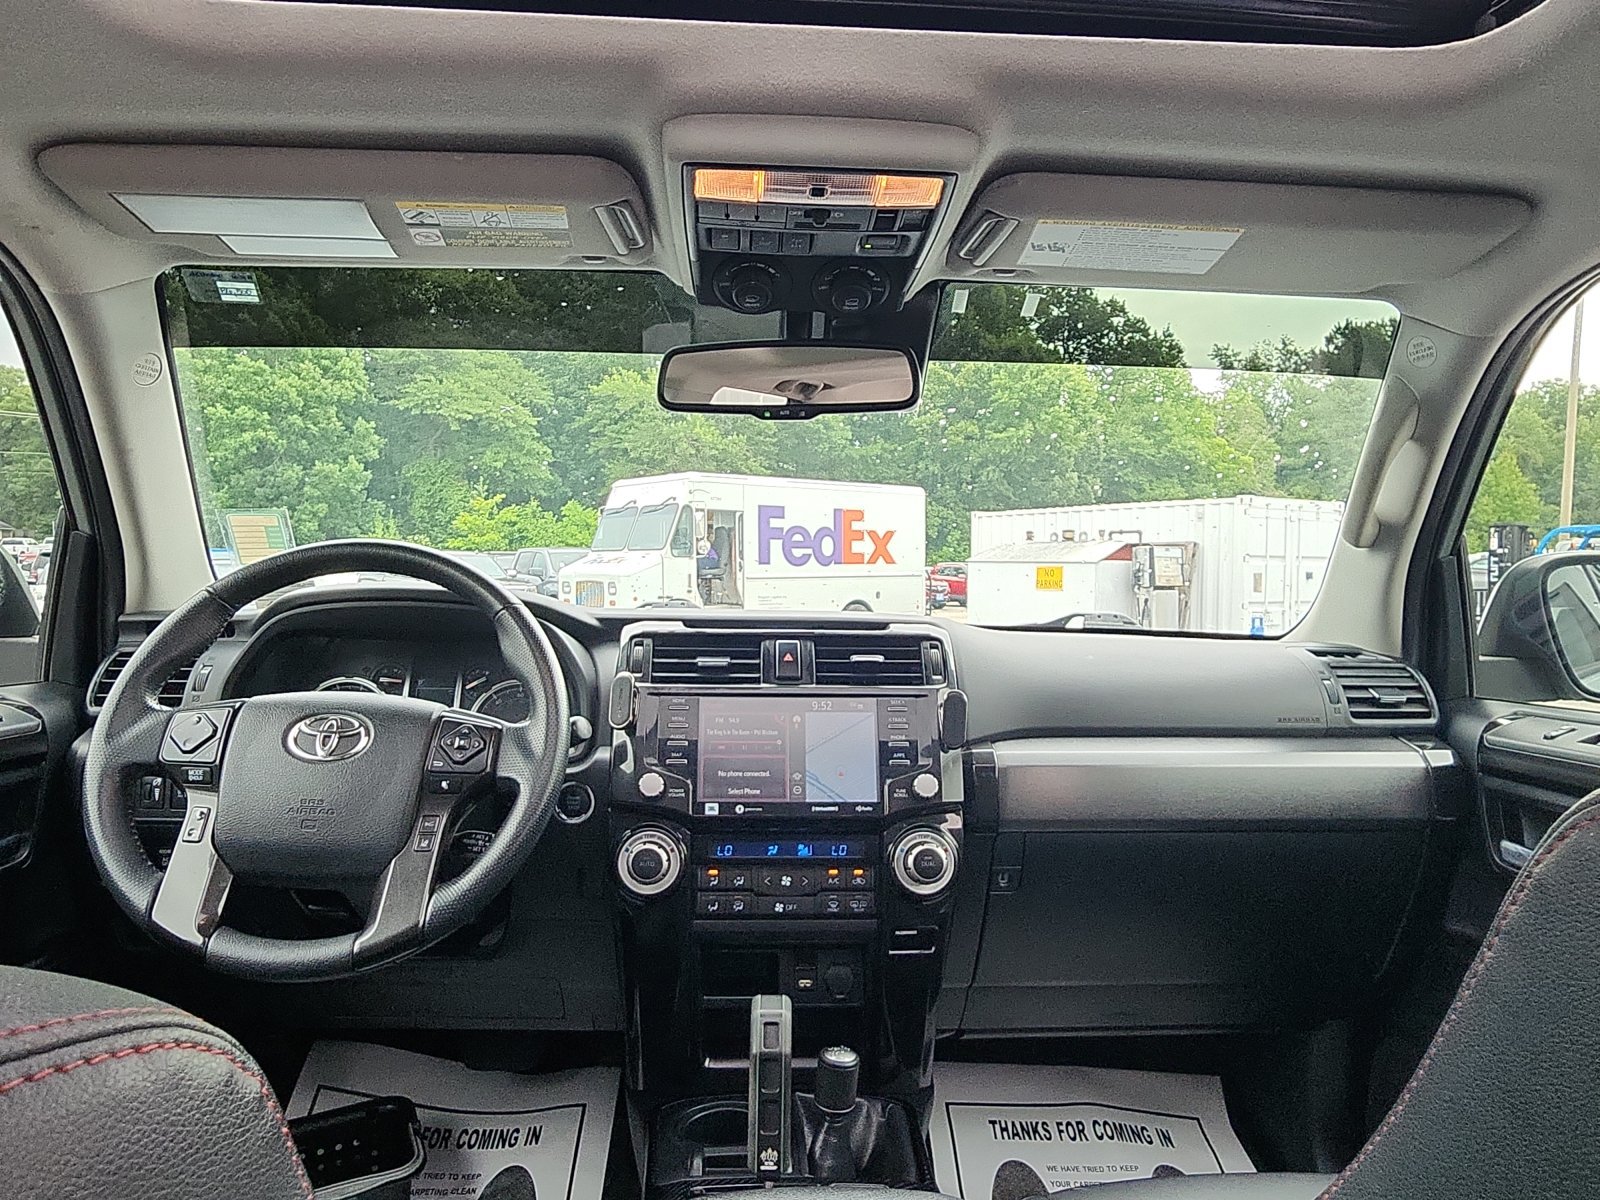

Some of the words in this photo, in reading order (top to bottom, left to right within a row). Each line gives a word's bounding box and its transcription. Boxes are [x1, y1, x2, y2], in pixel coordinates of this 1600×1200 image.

[757, 504, 897, 567] FedEx
[1044, 568, 1055, 578] NO
[1036, 578, 1063, 589] PARKING
[811, 701, 832, 711] 9:52
[727, 770, 743, 778] phone
[728, 787, 743, 795] Select
[744, 787, 761, 795] Phone
[785, 903, 798, 911] OFF
[456, 1127, 521, 1151] COMING
[523, 1124, 544, 1147] IN
[988, 1119, 1052, 1142] THANKS
[1055, 1120, 1090, 1142] FOR
[1092, 1119, 1154, 1146] COMING
[1154, 1127, 1176, 1149] IN
[1046, 1165, 1059, 1173] WE
[1060, 1165, 1081, 1173] HAVE
[1082, 1165, 1105, 1173] TRIED
[1105, 1165, 1118, 1173] TO
[1119, 1164, 1139, 1172] KEEP
[423, 1172, 446, 1180] TRIED
[448, 1172, 459, 1180] TO
[461, 1172, 482, 1180] KEEP
[1050, 1180, 1072, 1188] YOUR
[409, 1187, 448, 1197] ARPETING
[450, 1187, 477, 1196] CLEAN
